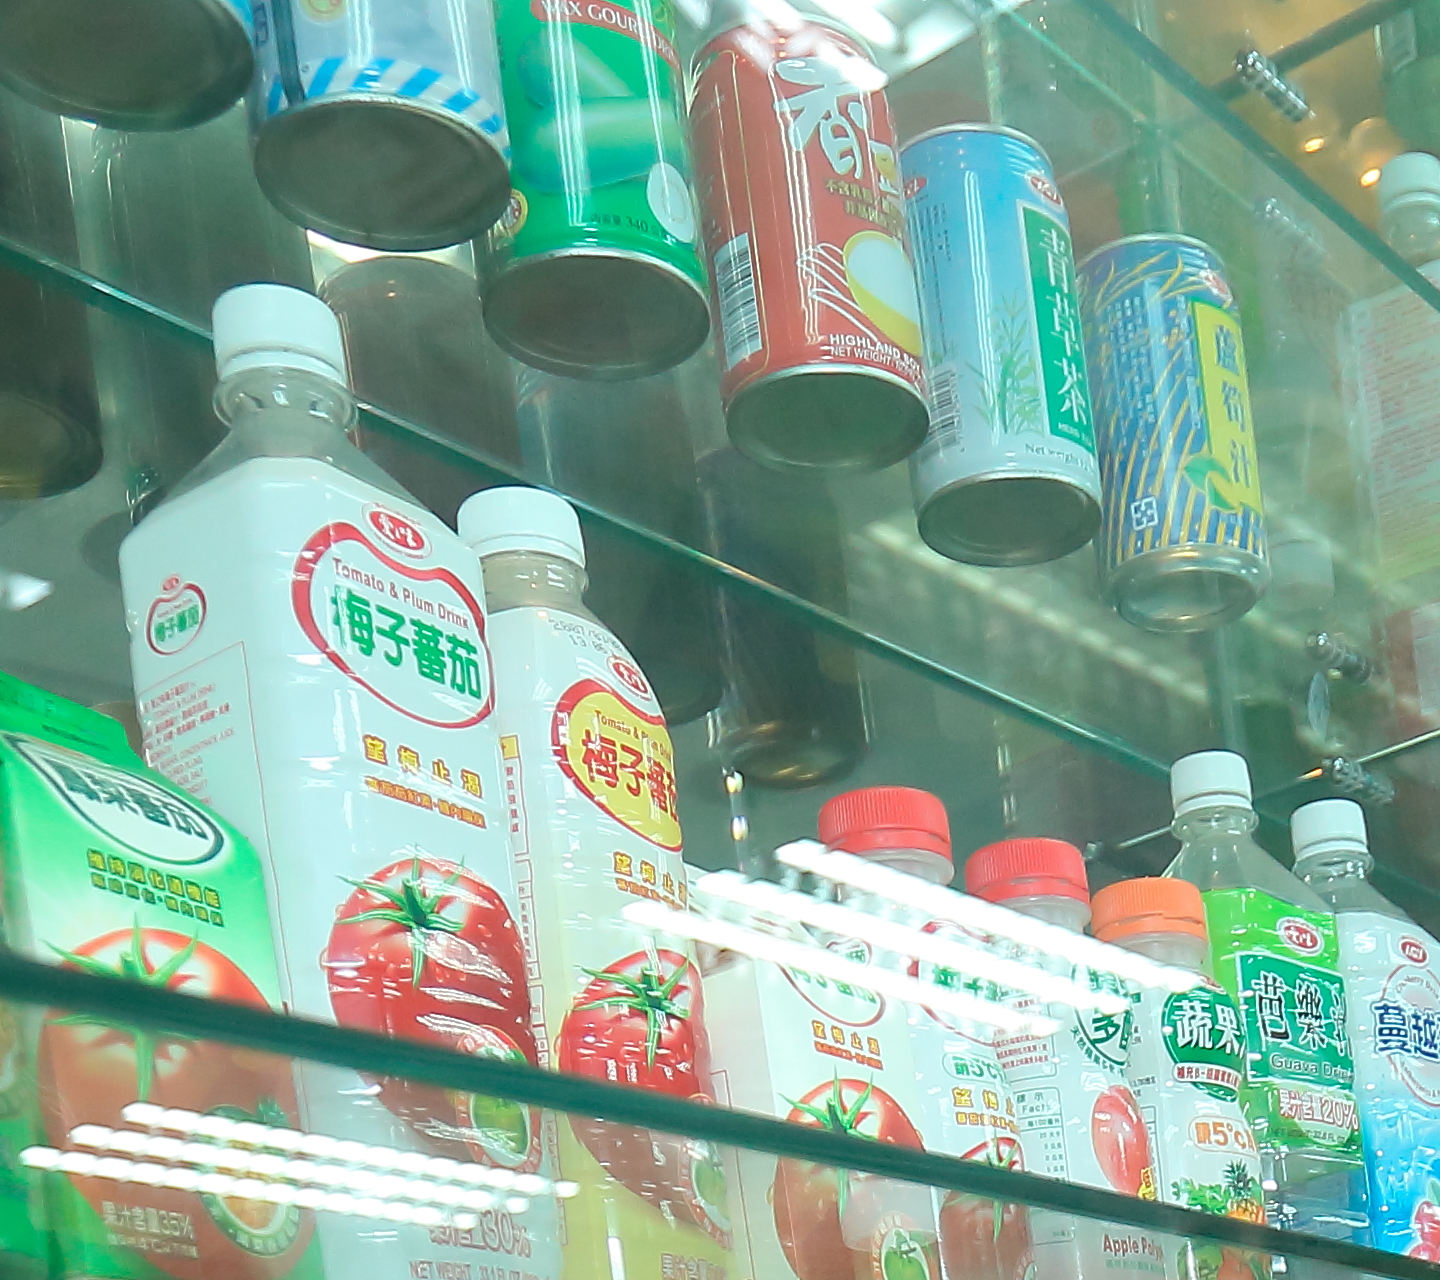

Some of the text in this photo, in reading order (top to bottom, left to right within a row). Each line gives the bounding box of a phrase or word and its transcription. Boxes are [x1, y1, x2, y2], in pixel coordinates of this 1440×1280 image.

[829, 333, 901, 360] HIGHLAND
[1040, 227, 1088, 424] 青草茶
[332, 556, 471, 631] Tomato & Plum Drink
[362, 733, 484, 800] 望梅止渴
[1175, 996, 1246, 1060] 蔬果
[1270, 1052, 1319, 1075] Guava
[1103, 1233, 1140, 1257] Apple
